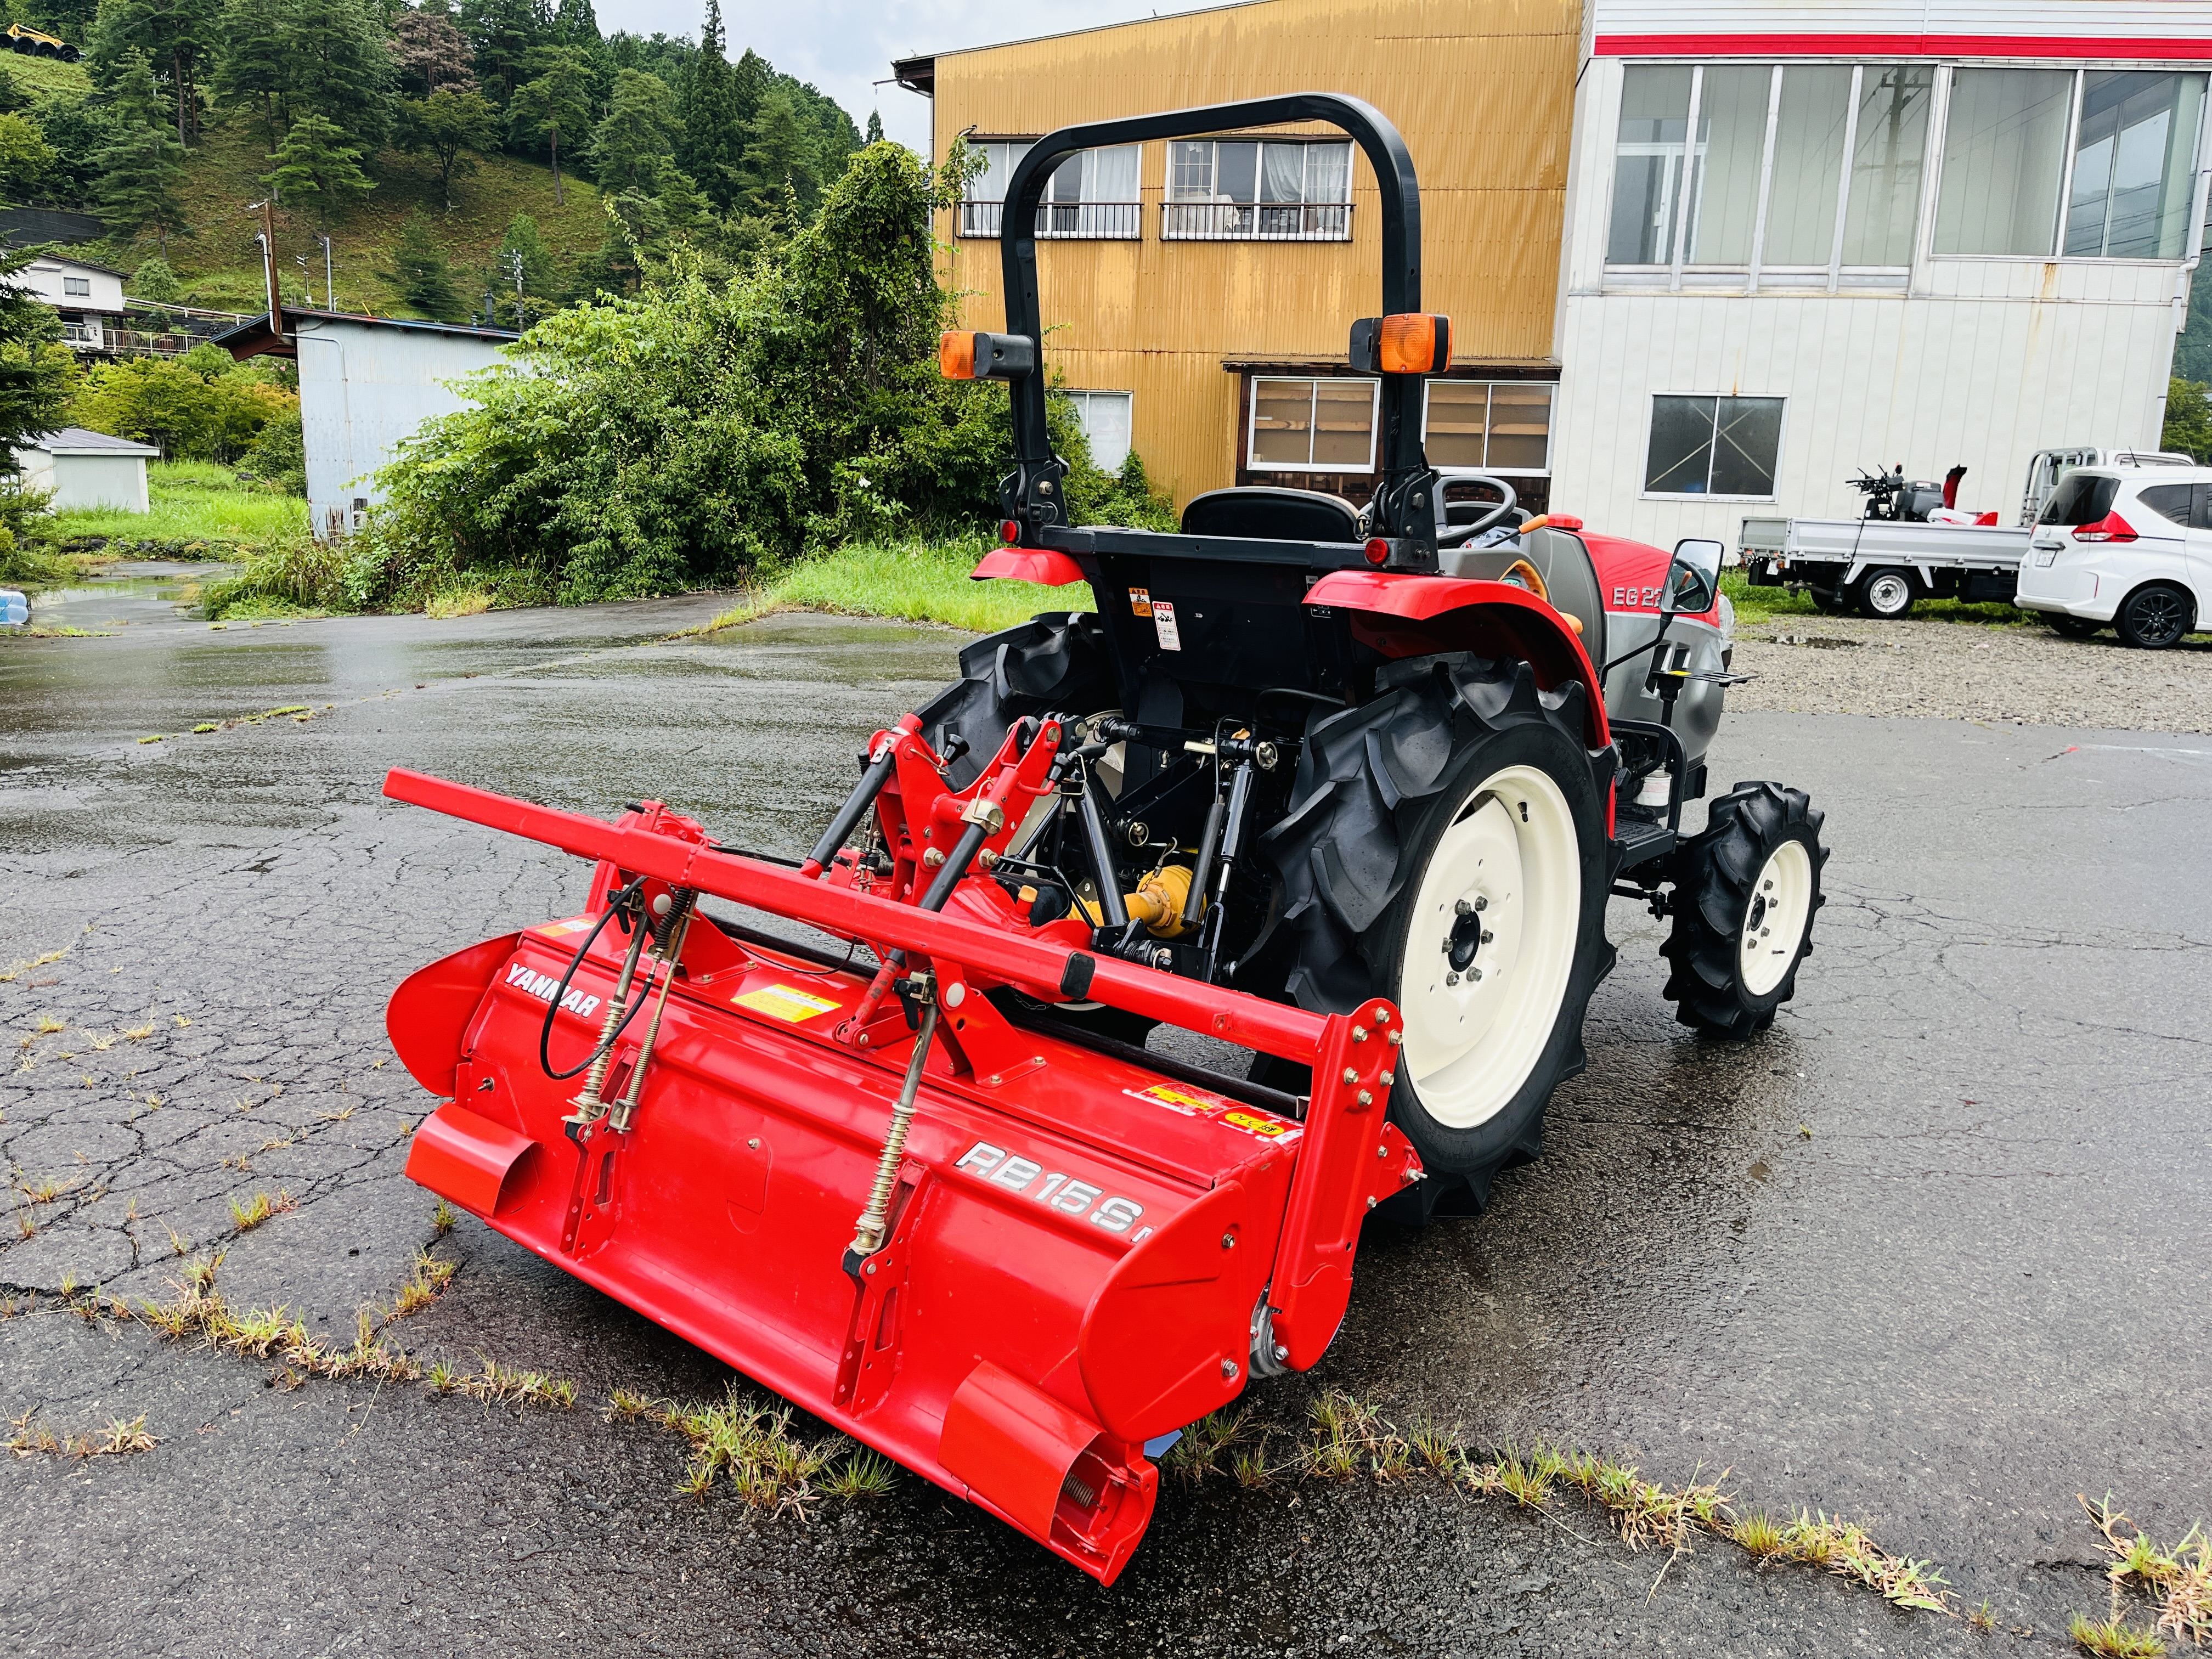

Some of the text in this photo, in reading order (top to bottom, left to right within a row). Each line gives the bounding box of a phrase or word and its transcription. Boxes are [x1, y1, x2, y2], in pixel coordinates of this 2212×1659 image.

[1612, 586, 1638, 606] EG
[505, 962, 602, 1018] YANMAR
[953, 1140, 1145, 1234] RB15S
